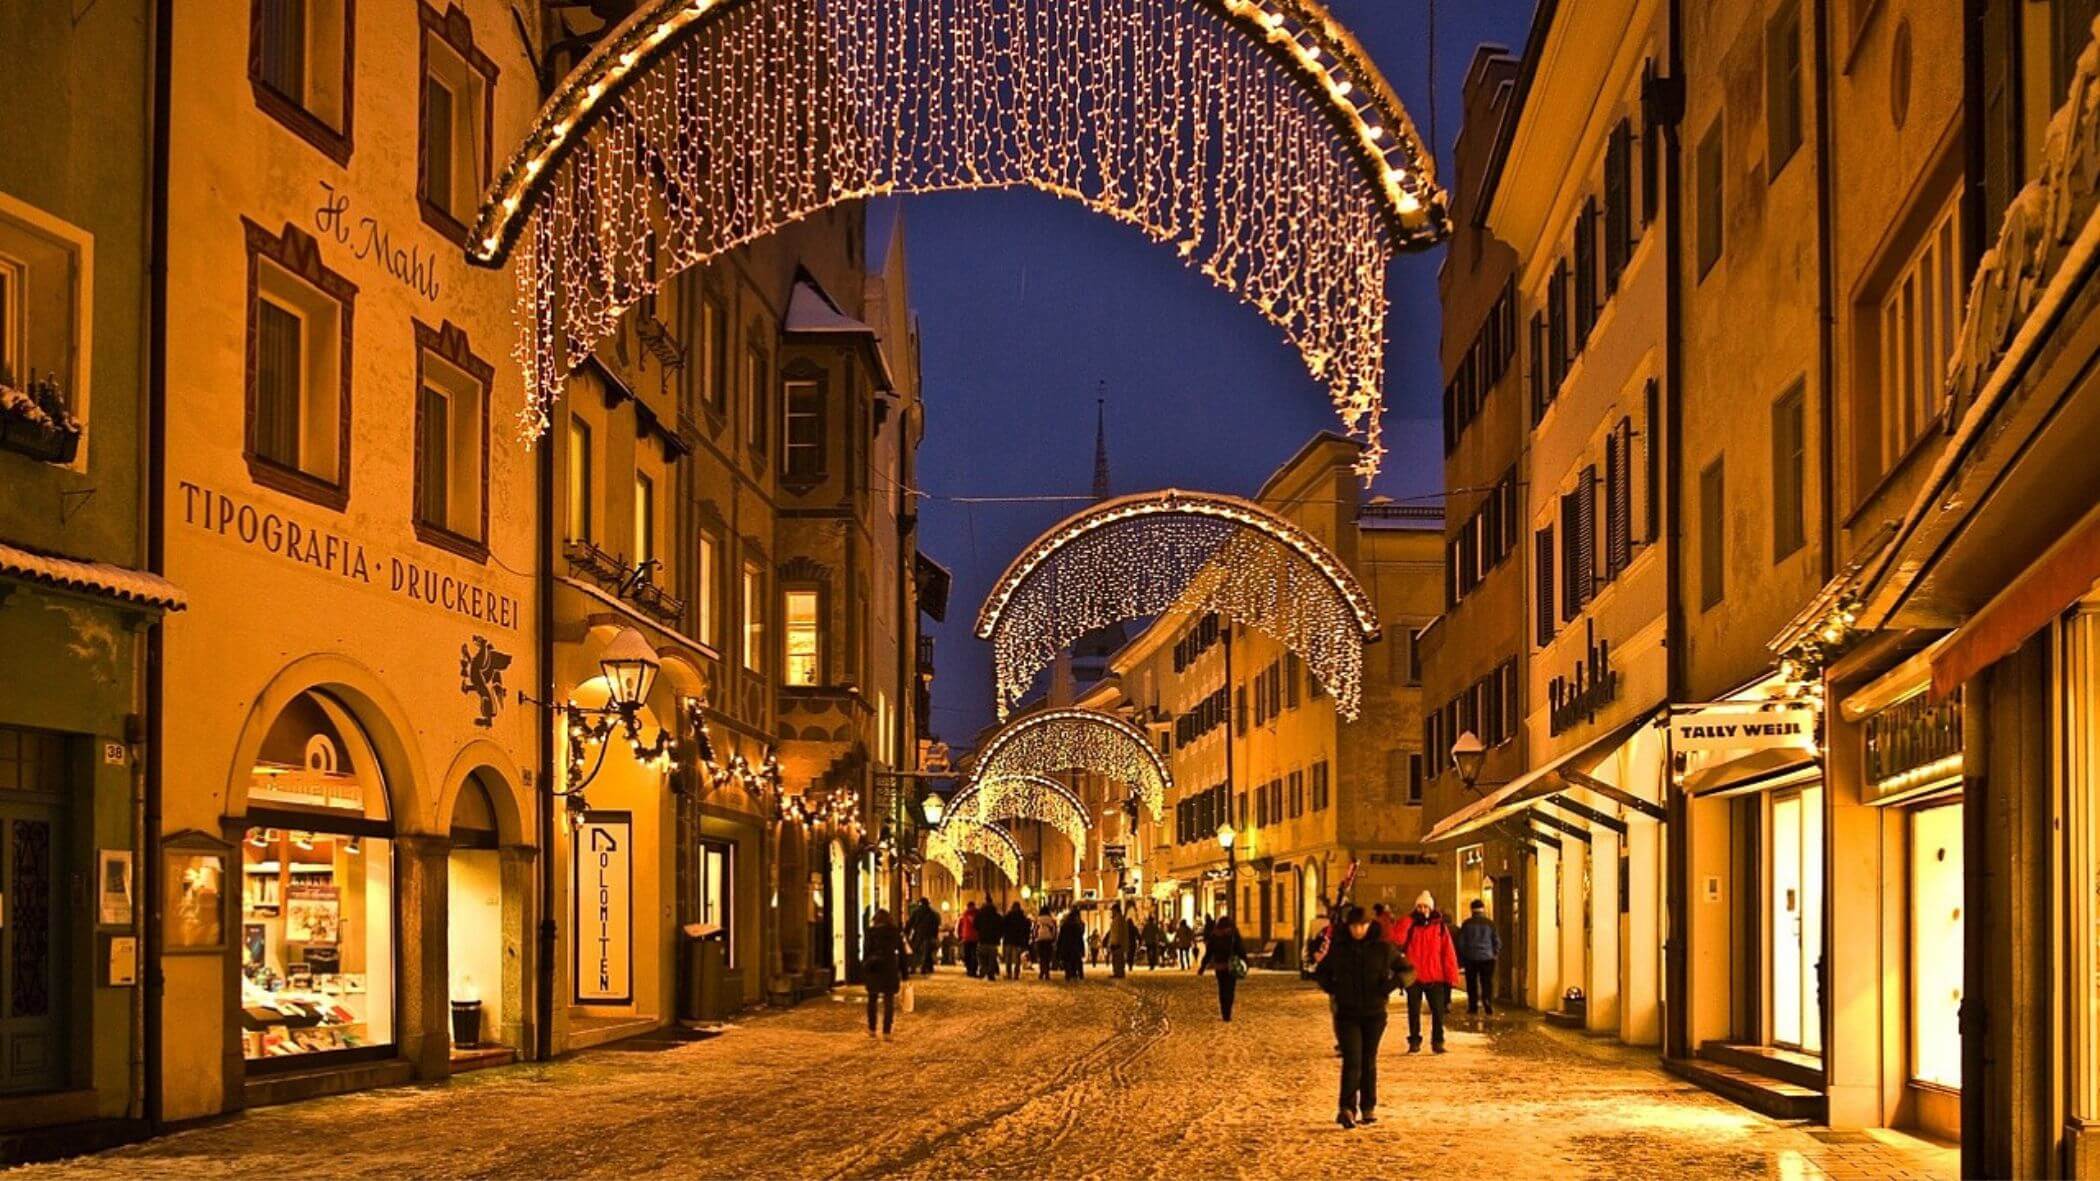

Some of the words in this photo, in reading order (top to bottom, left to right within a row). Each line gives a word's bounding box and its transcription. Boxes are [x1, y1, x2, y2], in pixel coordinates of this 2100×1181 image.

[316, 180, 354, 244] H.
[355, 217, 439, 301] Mahl
[180, 481, 370, 583] TIPOGRAFIA
[391, 557, 519, 630] DRUCKEREI
[107, 745, 122, 759] 38
[1680, 725, 1738, 739] TALLY
